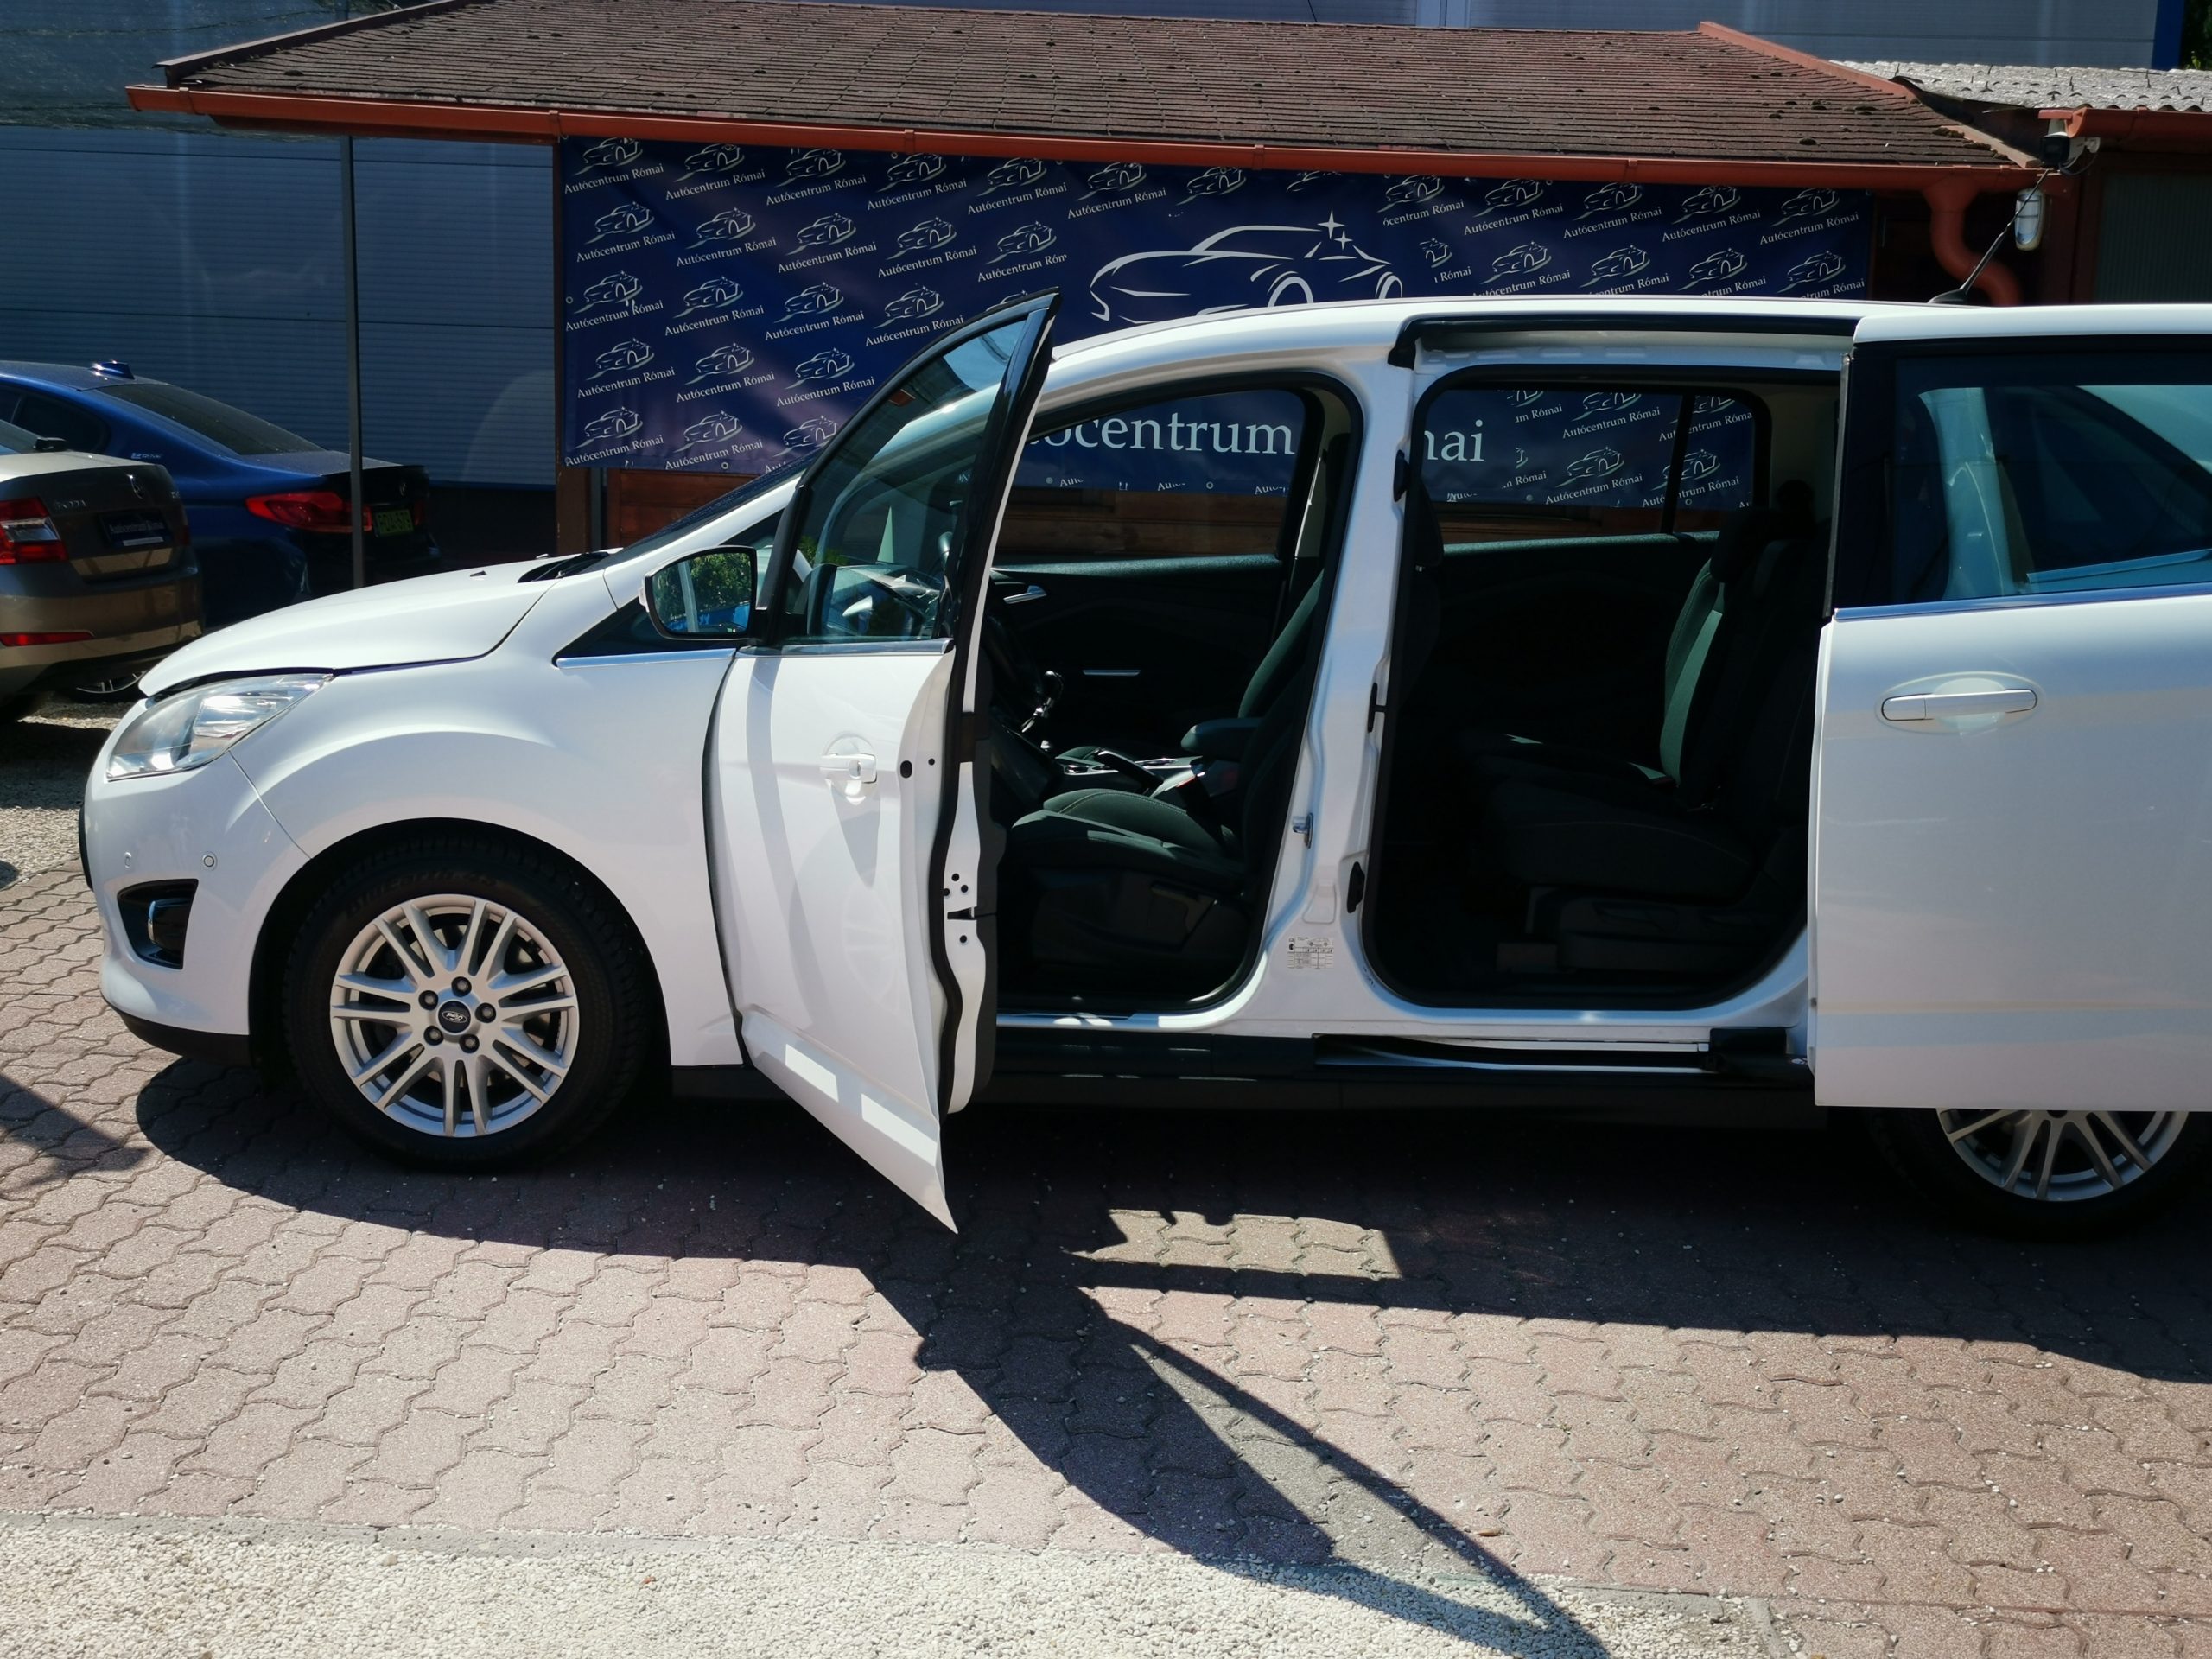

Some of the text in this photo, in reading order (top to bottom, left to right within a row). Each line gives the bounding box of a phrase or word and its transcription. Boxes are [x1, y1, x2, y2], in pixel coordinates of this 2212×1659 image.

[564, 163, 664, 194] Autócentrum Római
[665, 169, 766, 200] Autócentrum Római
[766, 175, 868, 206] Autócentrum Római
[867, 178, 968, 211] Autócentrum Római
[968, 183, 1067, 215] Autócentrum Római
[1068, 188, 1166, 219] Autócentrum Római
[1433, 199, 1465, 214] Római
[1464, 204, 1564, 236] Autócentrum Római
[1564, 207, 1662, 238] Autócentrum Római
[1662, 209, 1761, 242] Autócentrum Római
[1759, 212, 1859, 245] Autócentrum Római
[575, 231, 676, 263] Autócentrum Római
[677, 237, 777, 268] Autócentrum Római
[778, 242, 878, 274] Autócentrum Római
[878, 245, 977, 278] Autócentrum Római
[977, 261, 1042, 283] Autócentrum
[1440, 266, 1472, 283] Római
[1538, 270, 1571, 285] Római
[1637, 273, 1669, 289] Római
[1735, 276, 1767, 292] Római
[1834, 278, 1865, 296] Római
[565, 299, 664, 332] Autócentrum Római
[664, 304, 765, 337] Autócentrum Római
[765, 310, 865, 340] Autócentrum Római
[865, 315, 964, 347] Autócentrum Római
[577, 366, 676, 398] Autócentrum Római
[676, 372, 776, 403] Autócentrum Római
[776, 376, 874, 408] Autócentrum Római
[1531, 404, 1562, 418] Római
[1562, 406, 1661, 440] Autócentrum Római
[565, 435, 664, 467] Autócentrum Római
[664, 439, 763, 471] Autócentrum Római
[1516, 470, 1547, 486] Római
[1545, 473, 1643, 505] Autócentrum Római
[1707, 476, 1739, 491] Római
